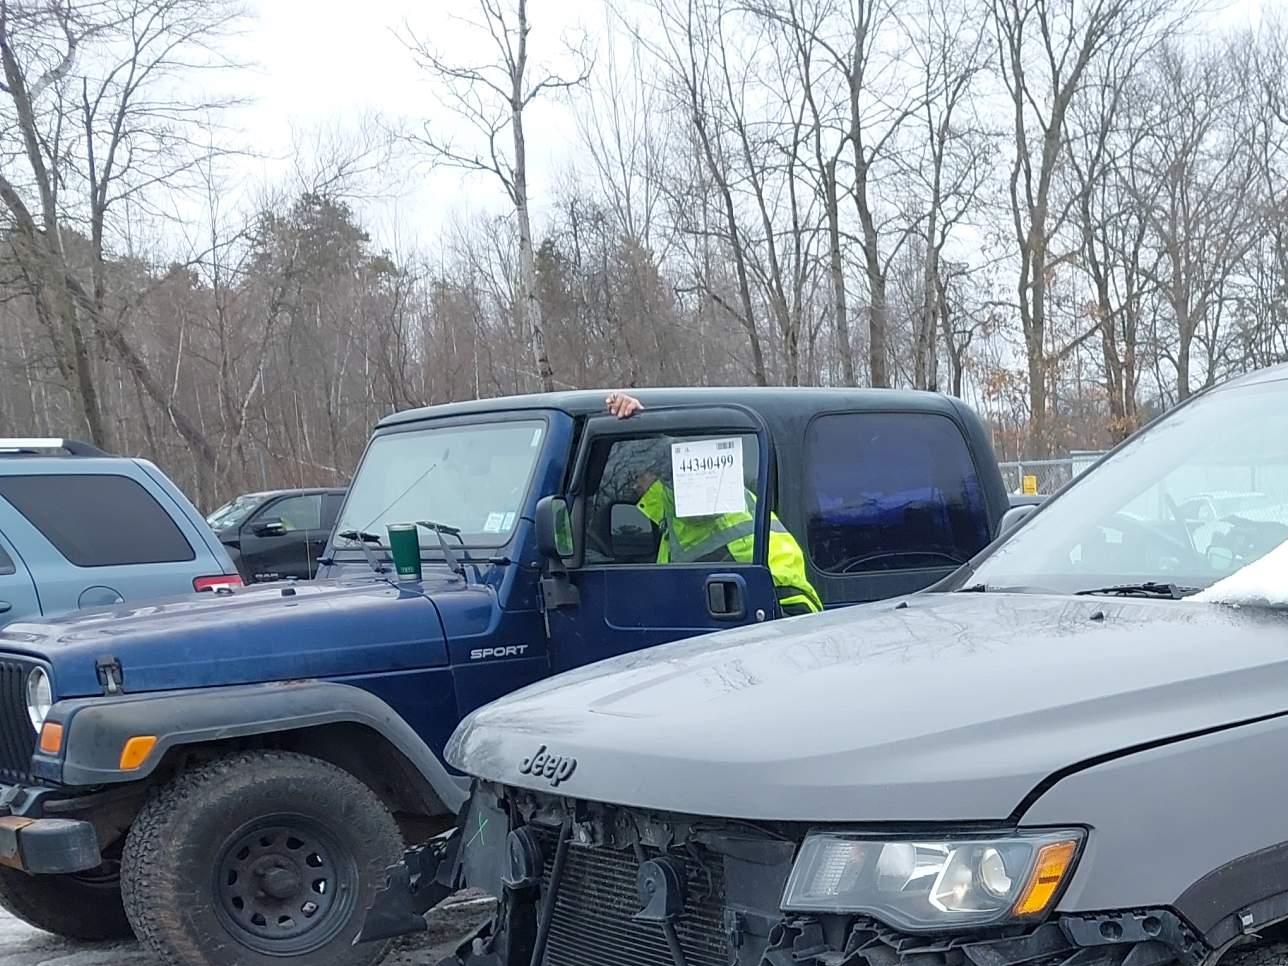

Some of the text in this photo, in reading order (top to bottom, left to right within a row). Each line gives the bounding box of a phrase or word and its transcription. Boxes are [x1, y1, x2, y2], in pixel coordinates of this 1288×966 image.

[679, 454, 734, 473] 44340499
[470, 644, 529, 660] SPORT
[519, 745, 578, 787] Jeep
